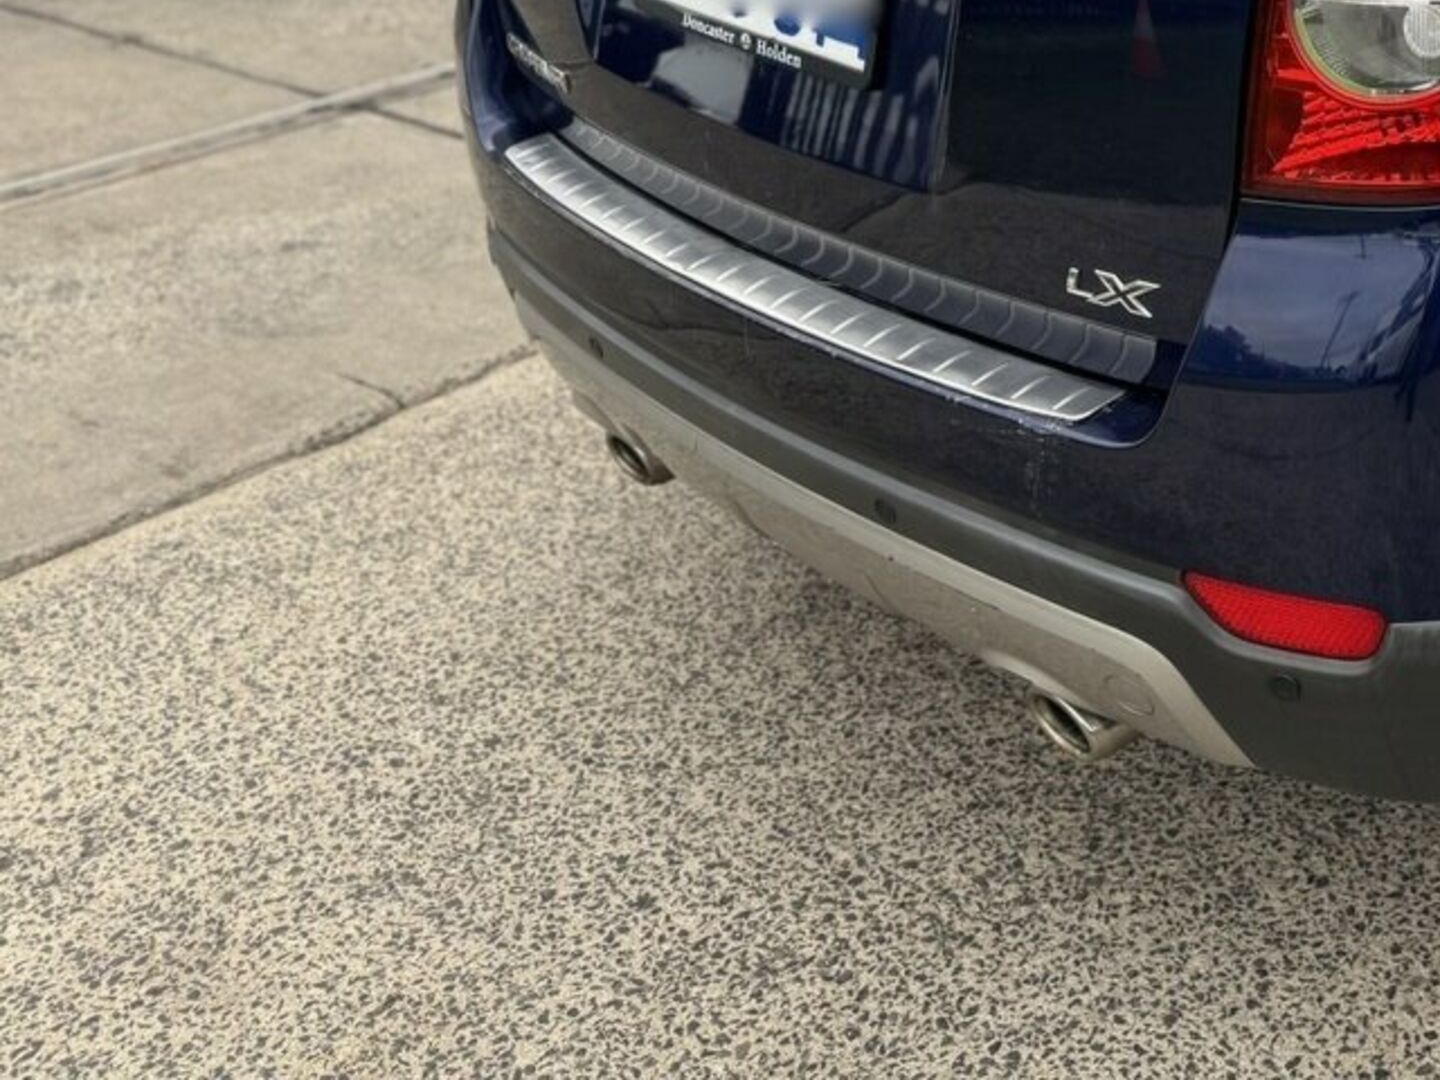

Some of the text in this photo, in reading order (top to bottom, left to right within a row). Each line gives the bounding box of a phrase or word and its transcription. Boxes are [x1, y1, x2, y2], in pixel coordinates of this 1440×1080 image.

[681, 13, 803, 68] Doncaster Holden
[1066, 266, 1162, 318] LX
